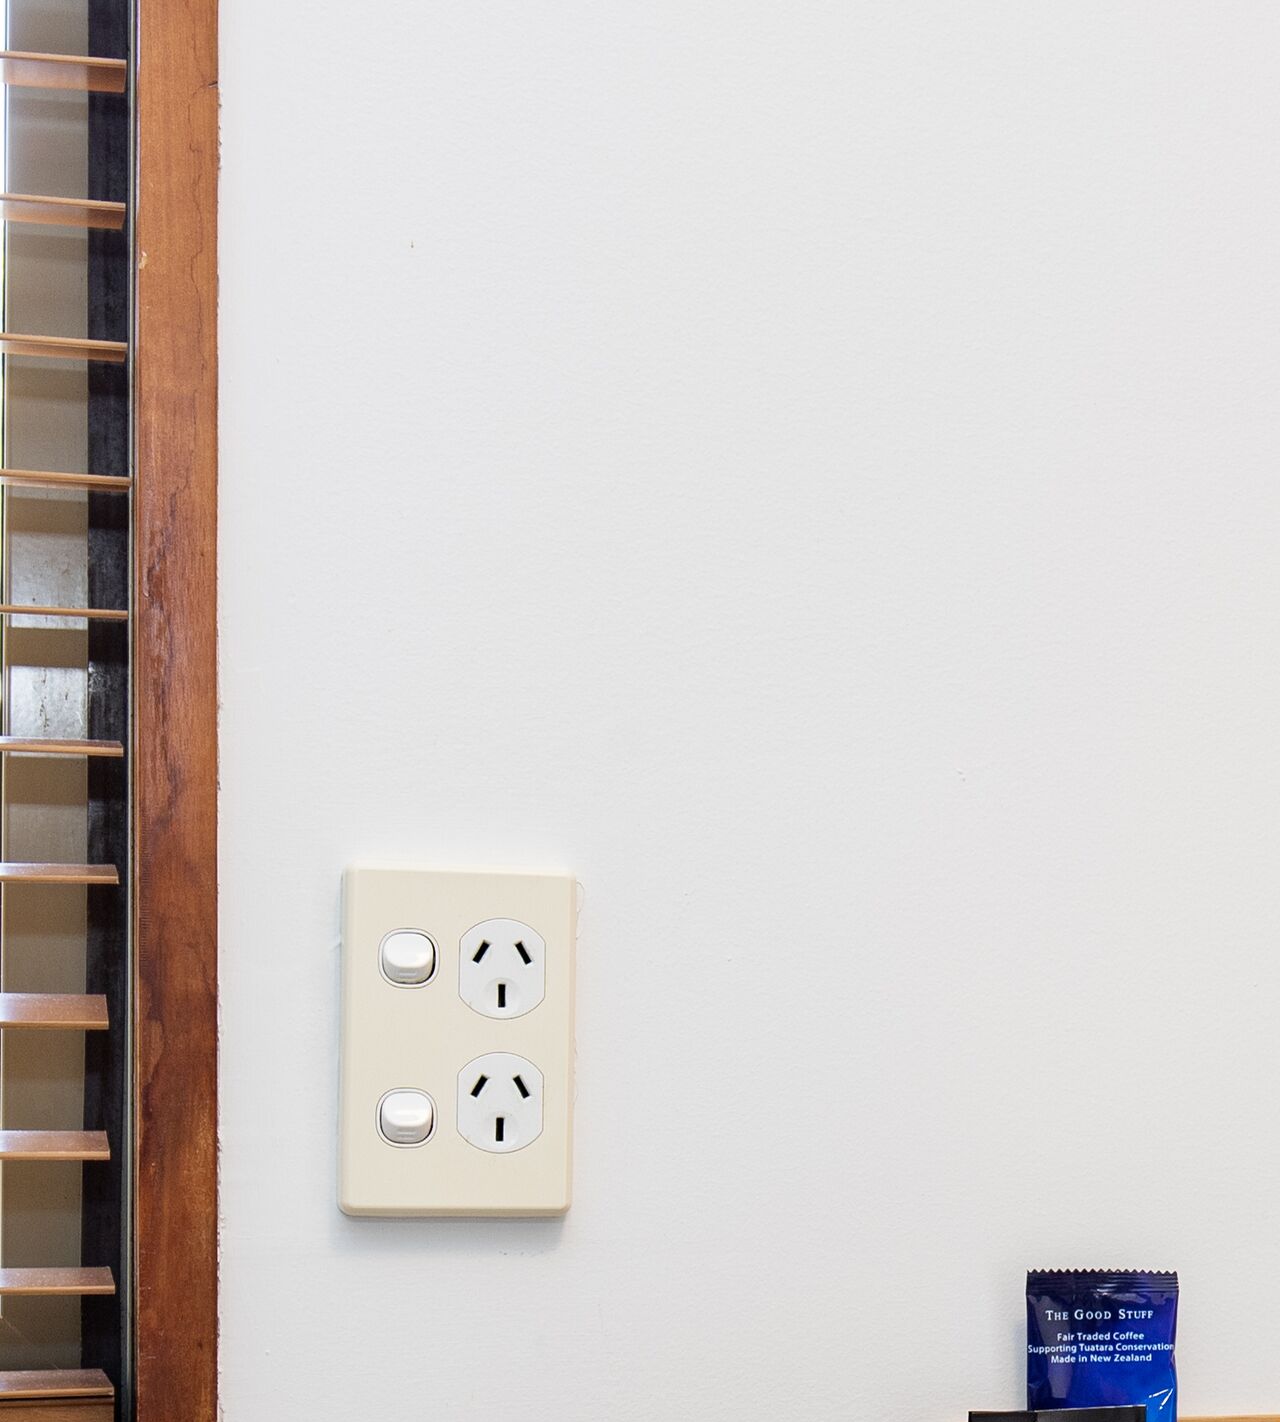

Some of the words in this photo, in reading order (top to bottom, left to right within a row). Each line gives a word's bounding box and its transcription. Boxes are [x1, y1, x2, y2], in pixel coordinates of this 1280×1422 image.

[1057, 1333, 1075, 1342] Fair
[1077, 1332, 1111, 1341] Traded
[1113, 1332, 1145, 1341] Coffee
[1028, 1344, 1077, 1355] Supporting
[1079, 1343, 1113, 1352] Tuatara
[1115, 1343, 1175, 1351] Conservation
[1051, 1355, 1076, 1364] Made
[1078, 1354, 1088, 1363] in
[1090, 1354, 1112, 1363] New
[1114, 1353, 1152, 1362] Zealand
